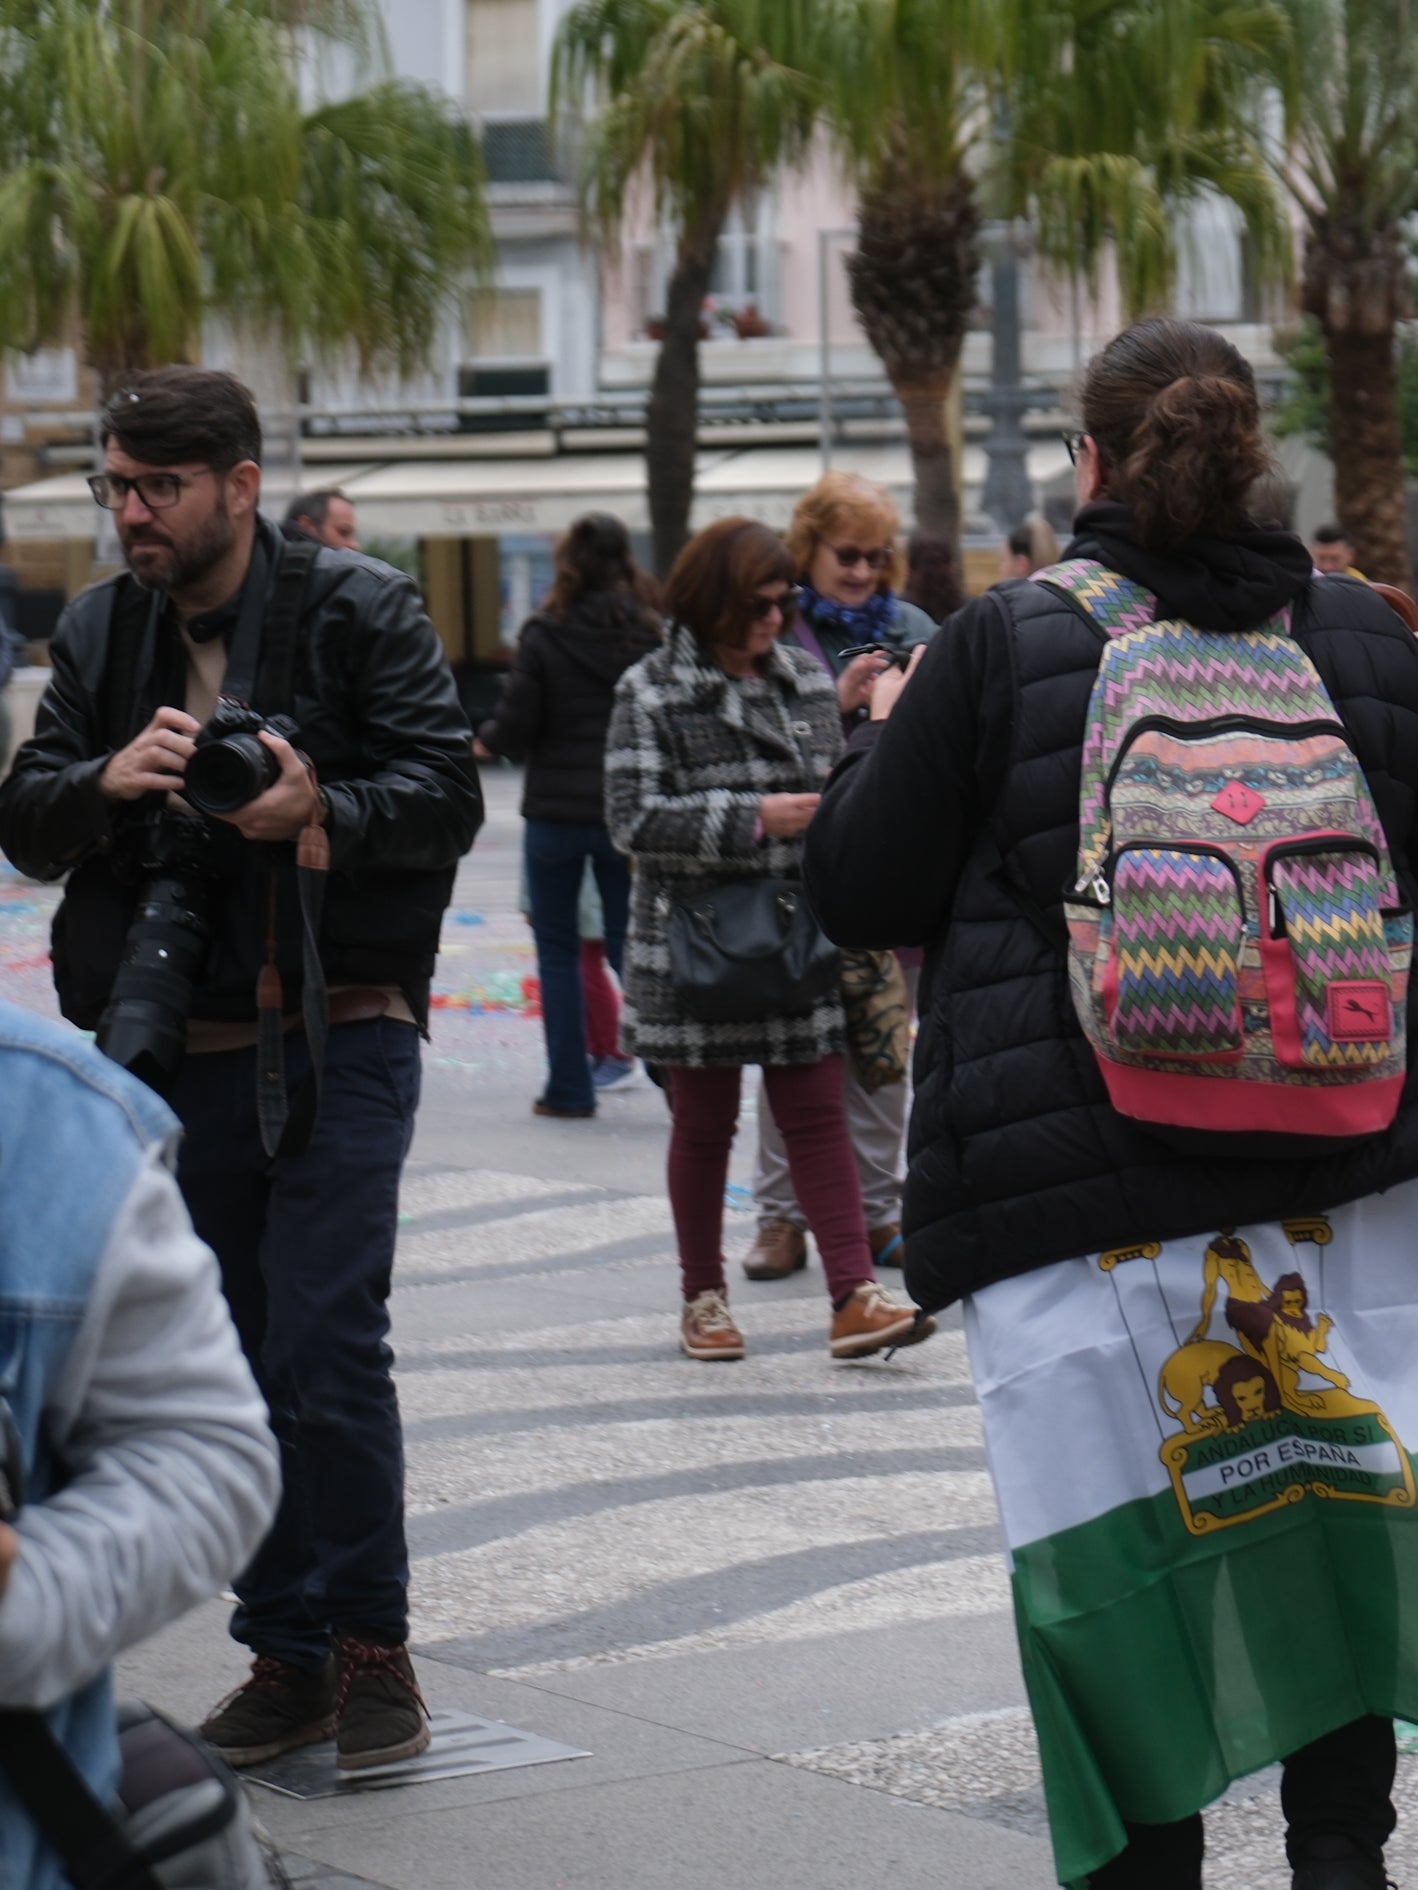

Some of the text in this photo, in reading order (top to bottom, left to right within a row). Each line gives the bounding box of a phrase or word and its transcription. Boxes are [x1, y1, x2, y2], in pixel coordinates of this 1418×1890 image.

[1308, 1425, 1347, 1444] POR
[1220, 1439, 1361, 1484] POR ESPAÑA
[1212, 1464, 1373, 1509] Y LA HUMANIDAD
